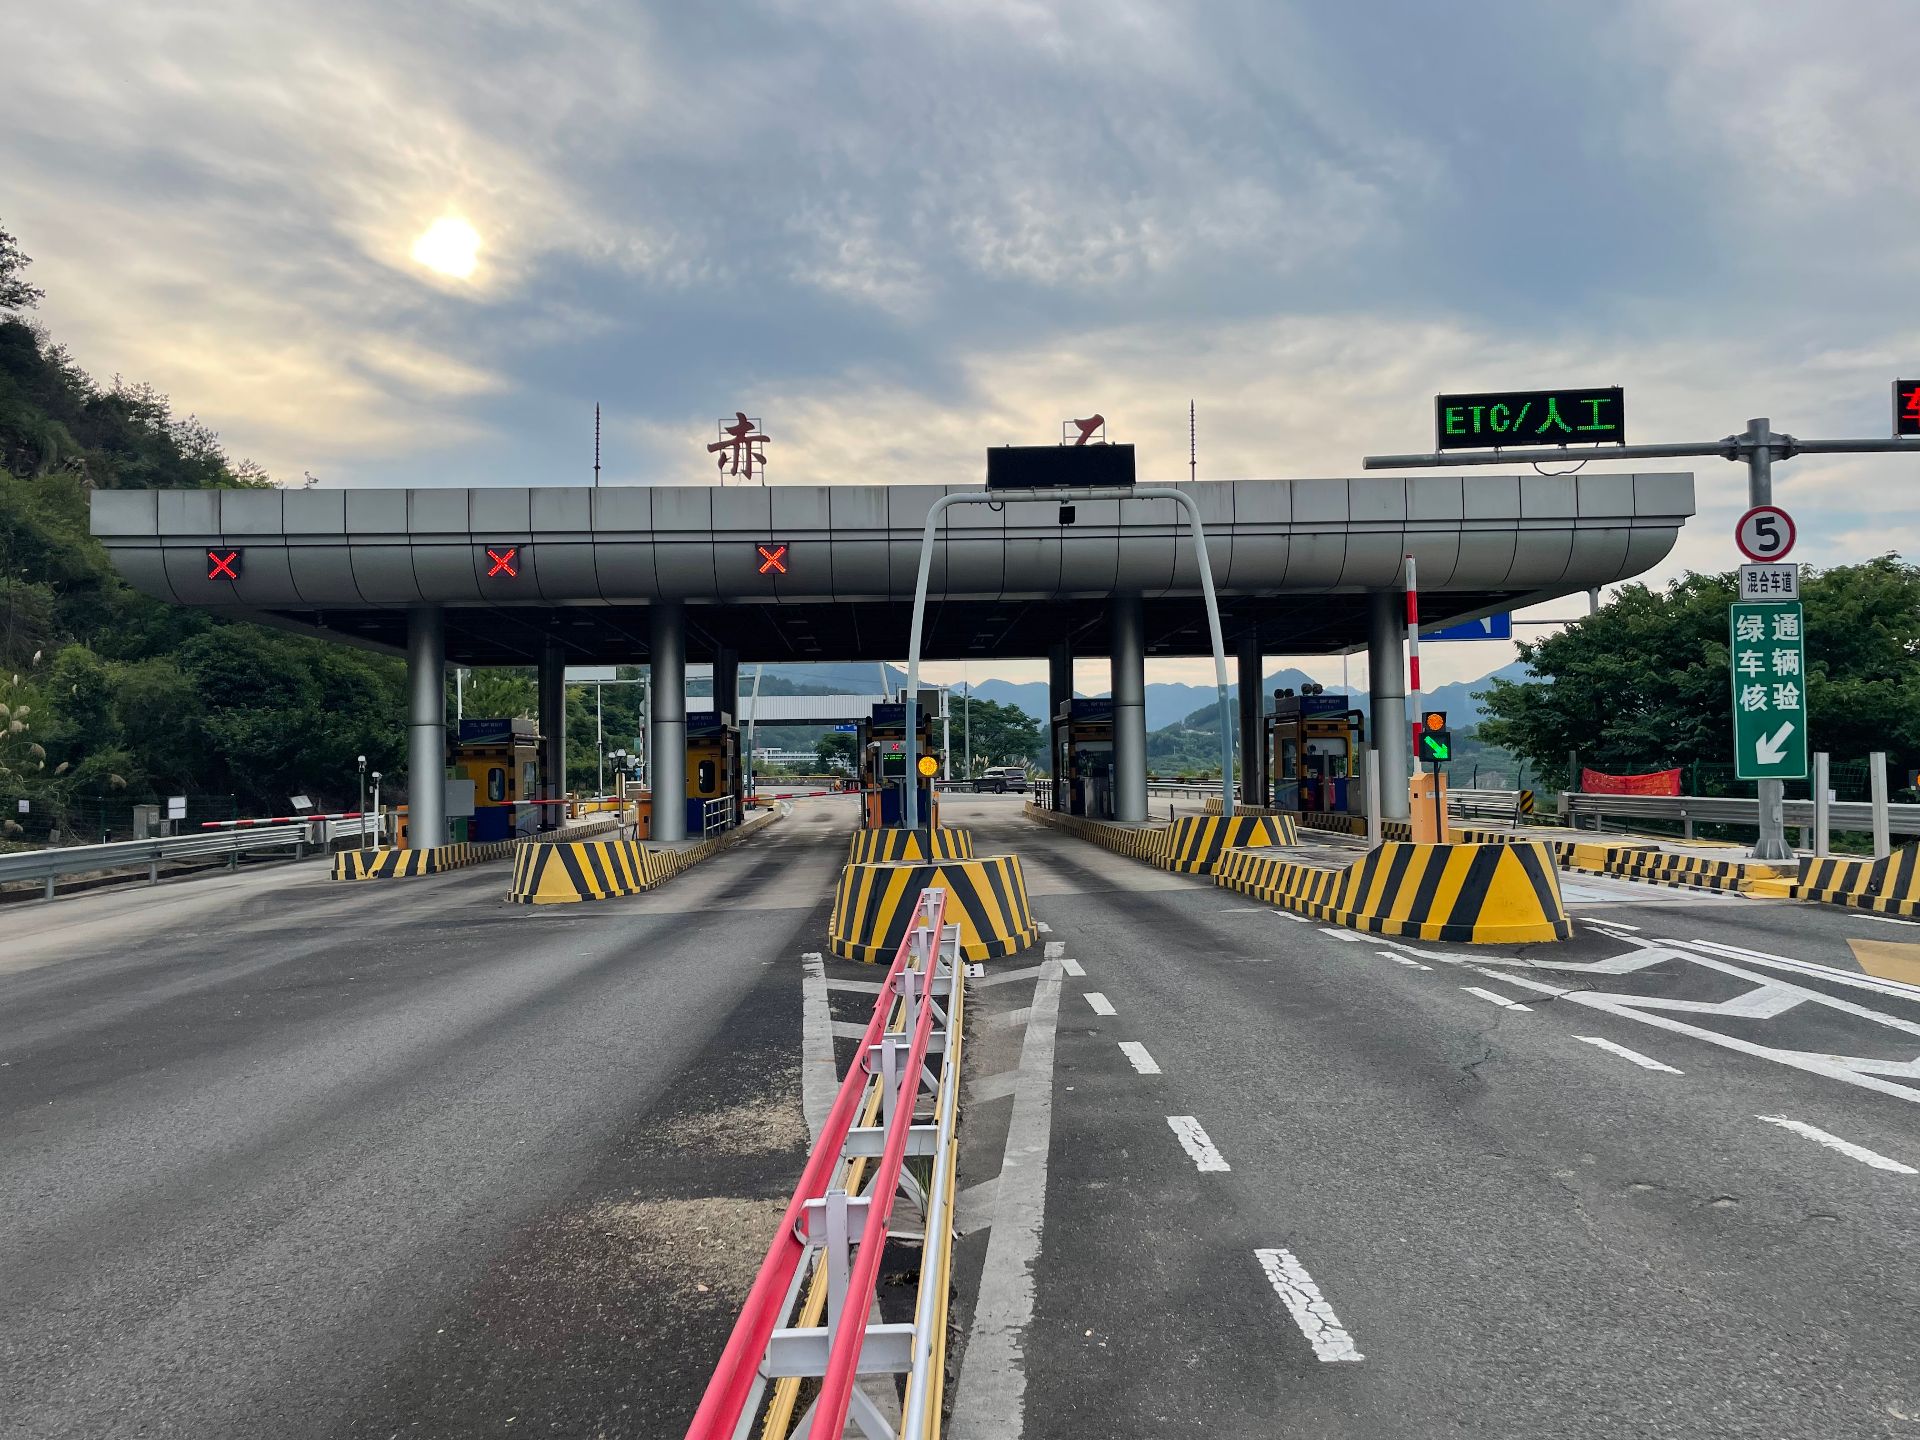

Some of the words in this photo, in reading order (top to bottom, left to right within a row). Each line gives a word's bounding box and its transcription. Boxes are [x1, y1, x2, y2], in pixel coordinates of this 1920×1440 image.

[1446, 397, 1616, 434] ETC/人工
[707, 412, 770, 480] 赤
[1755, 516, 1781, 552] 5
[1747, 571, 1793, 594] 混合车道
[1736, 613, 1800, 643] 绿通
[1738, 648, 1800, 679] 车辆
[1739, 682, 1800, 712] 核验
